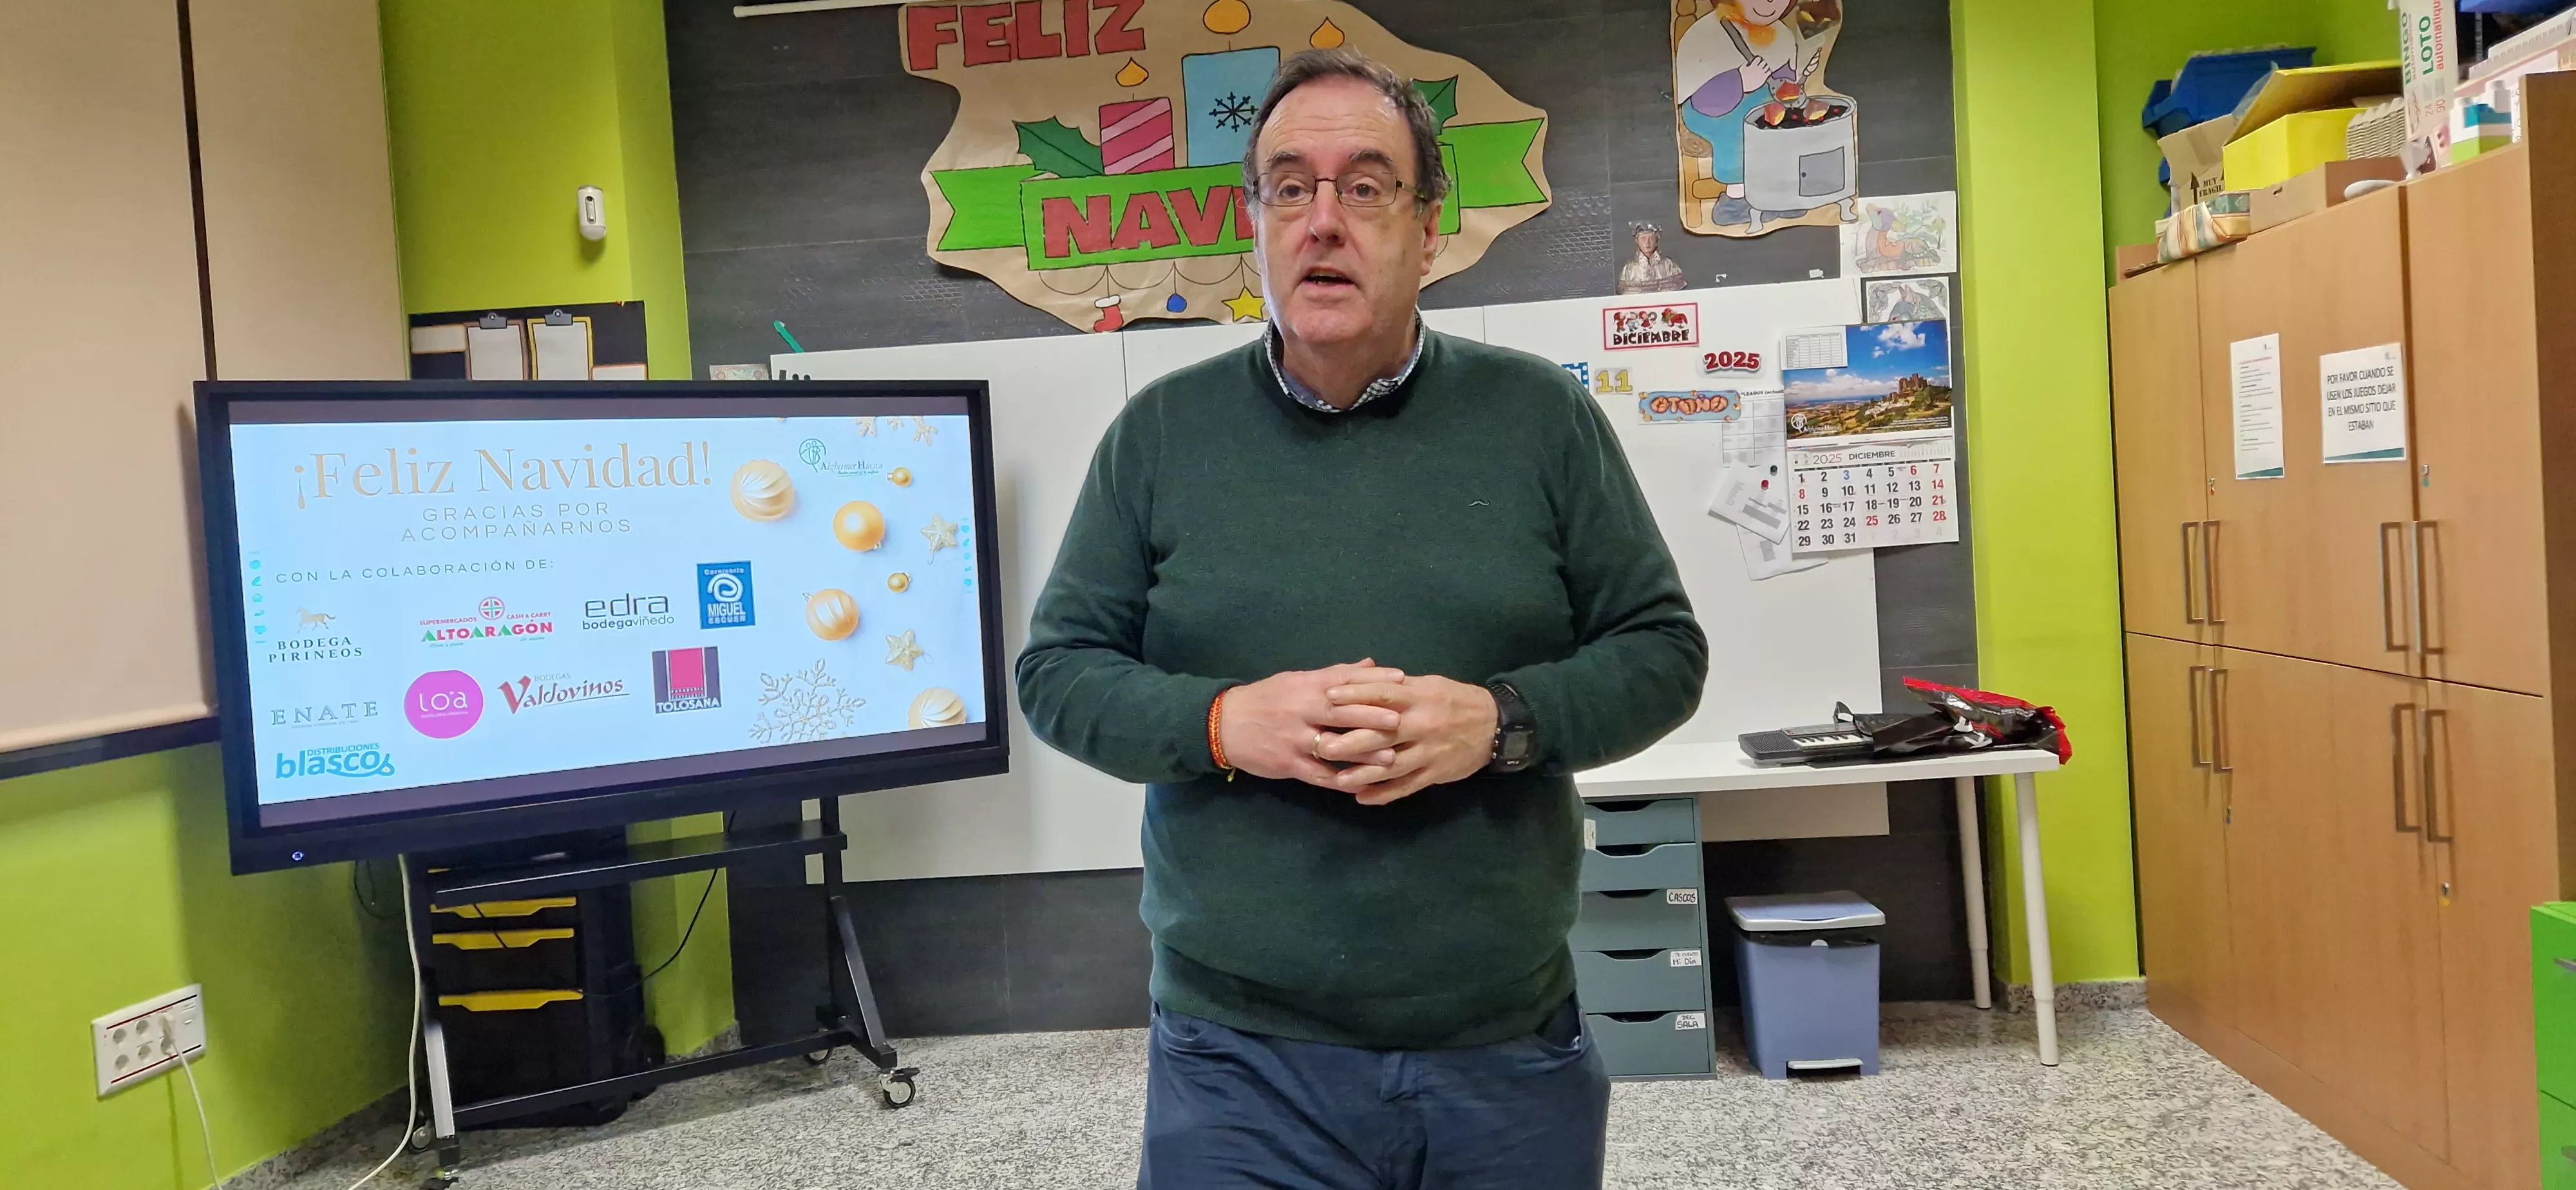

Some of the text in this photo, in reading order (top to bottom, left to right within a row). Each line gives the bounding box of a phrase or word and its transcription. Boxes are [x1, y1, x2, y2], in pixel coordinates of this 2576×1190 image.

[907, 0, 1146, 71] FELIZ
[2419, 15, 2434, 76] LOTO
[2401, 12, 2412, 86] BINGO
[2202, 176, 2218, 188] MUY
[1041, 185, 1255, 259] NAVI
[1613, 329, 1690, 346] DICIEMBRE
[1703, 350, 1761, 370] 2025
[2327, 365, 2395, 384] POR FAVOR CUANDO SE
[2327, 382, 2396, 401] USEN LOS JUEGOS DEJAR
[1650, 394, 1728, 415] OTOÑO
[2328, 400, 2396, 417] EN EL MISMO SITIO QUE
[2348, 420, 2374, 431] ESTABAN
[1813, 451, 1896, 465] 2025 DICIEMBRE
[294, 440, 712, 511] ¡Feliz Navidad!
[1798, 473, 1804, 484] 1
[1821, 471, 1828, 482] 2
[1843, 469, 1850, 480] 3
[1866, 468, 1873, 478] 4
[1888, 466, 1895, 477] 5
[1910, 465, 1917, 475] 6
[1933, 463, 1940, 474] 7
[1799, 478, 1944, 500] 8 9 10 11 12 13 14
[422, 502, 609, 522] GRACIAS POR
[1797, 495, 1944, 515] 15 16 17 18 19 20 21
[401, 519, 631, 543] ACOMPAÑARNOS
[1797, 511, 1946, 531] 22 23 24 25 26 27 28
[1798, 536, 1811, 547] 29
[1821, 534, 1835, 545] 30
[1844, 533, 1856, 543] 31
[276, 559, 554, 583] CON LA COLABORACIÓN DE:
[585, 592, 669, 618] edra
[707, 601, 746, 618] MIGUEL
[419, 616, 477, 626] SUPERMERCADOS
[421, 619, 553, 643] ALTOARAGÓN
[278, 636, 352, 650] BODEGA
[268, 647, 363, 663] PIRINEOS
[534, 673, 571, 682] BODEGAS
[497, 675, 624, 715] Valdovinos
[656, 697, 721, 713] TOLOSANA
[271, 701, 378, 726] ENATE
[307, 742, 380, 756] DISTRIBUCIONES
[276, 750, 388, 779] blasco
[1669, 892, 1696, 903] CASCOS
[1677, 1020, 1699, 1028] SALA
